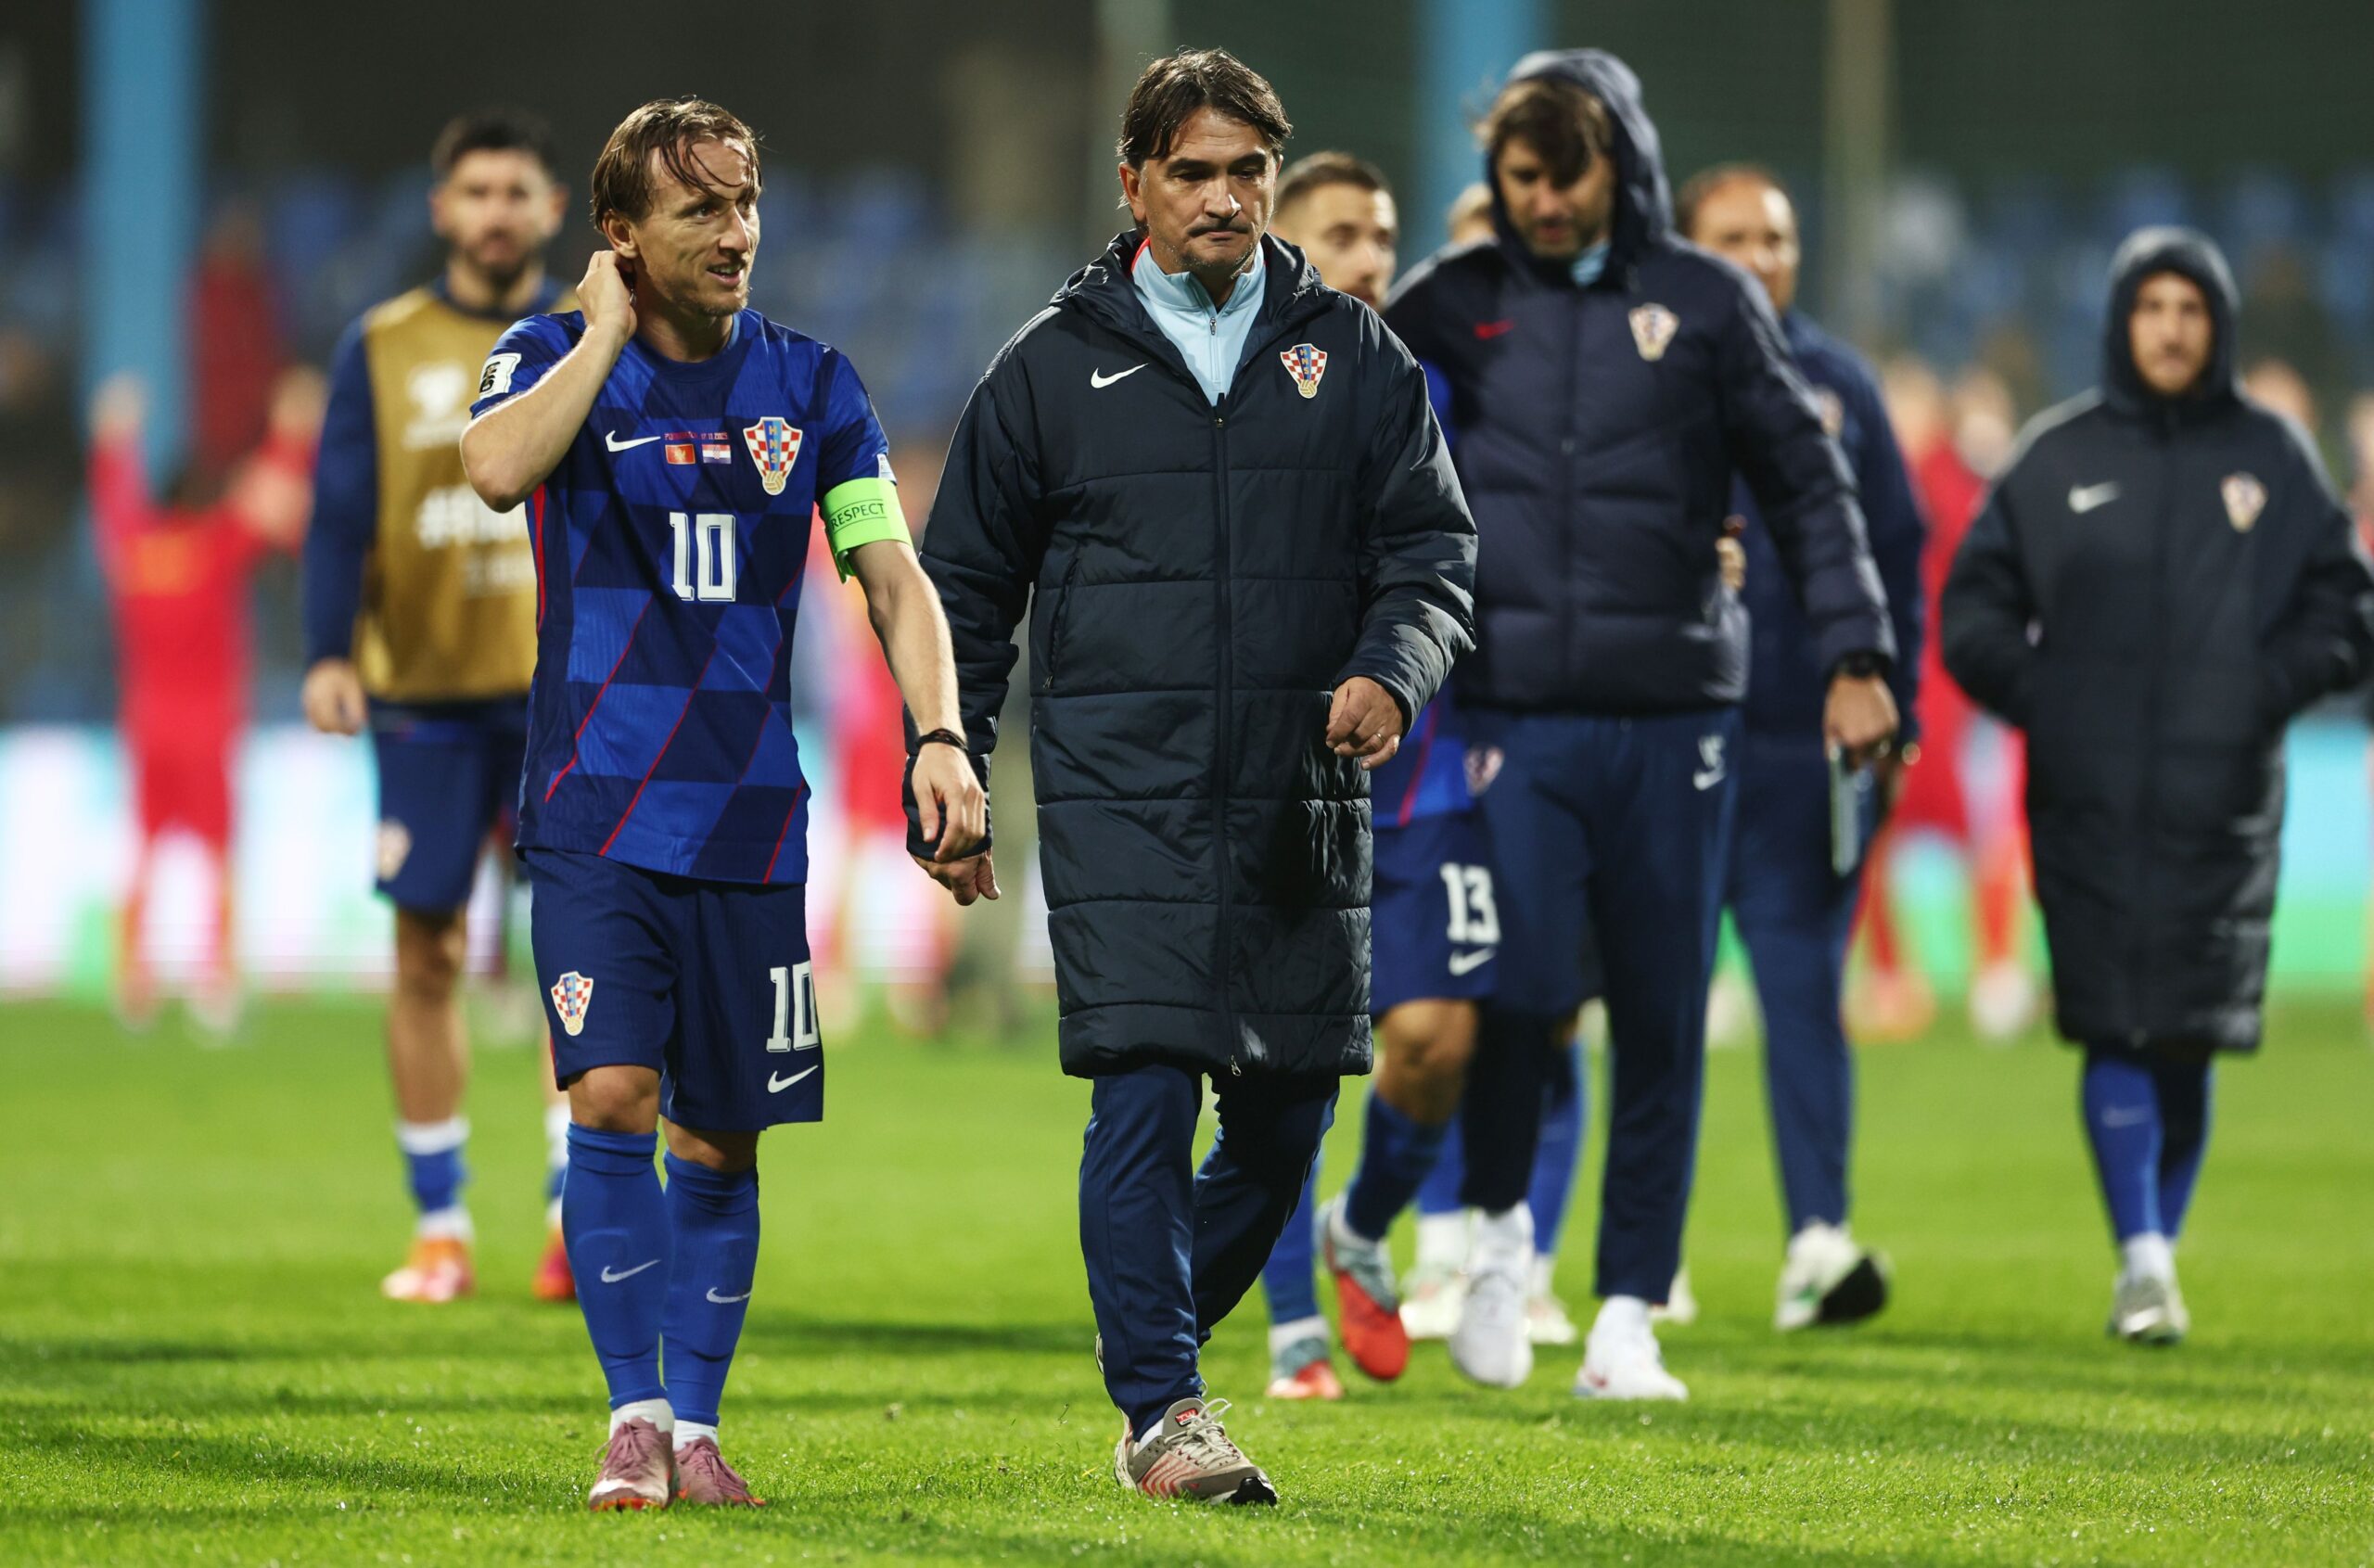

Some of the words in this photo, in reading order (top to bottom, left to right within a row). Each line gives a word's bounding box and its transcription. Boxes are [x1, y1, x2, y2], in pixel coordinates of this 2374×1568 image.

[768, 425, 778, 464] HNS
[669, 511, 736, 602] 10
[830, 503, 885, 530] RESPECT
[1440, 861, 1501, 944] 13
[766, 960, 820, 1052] 10
